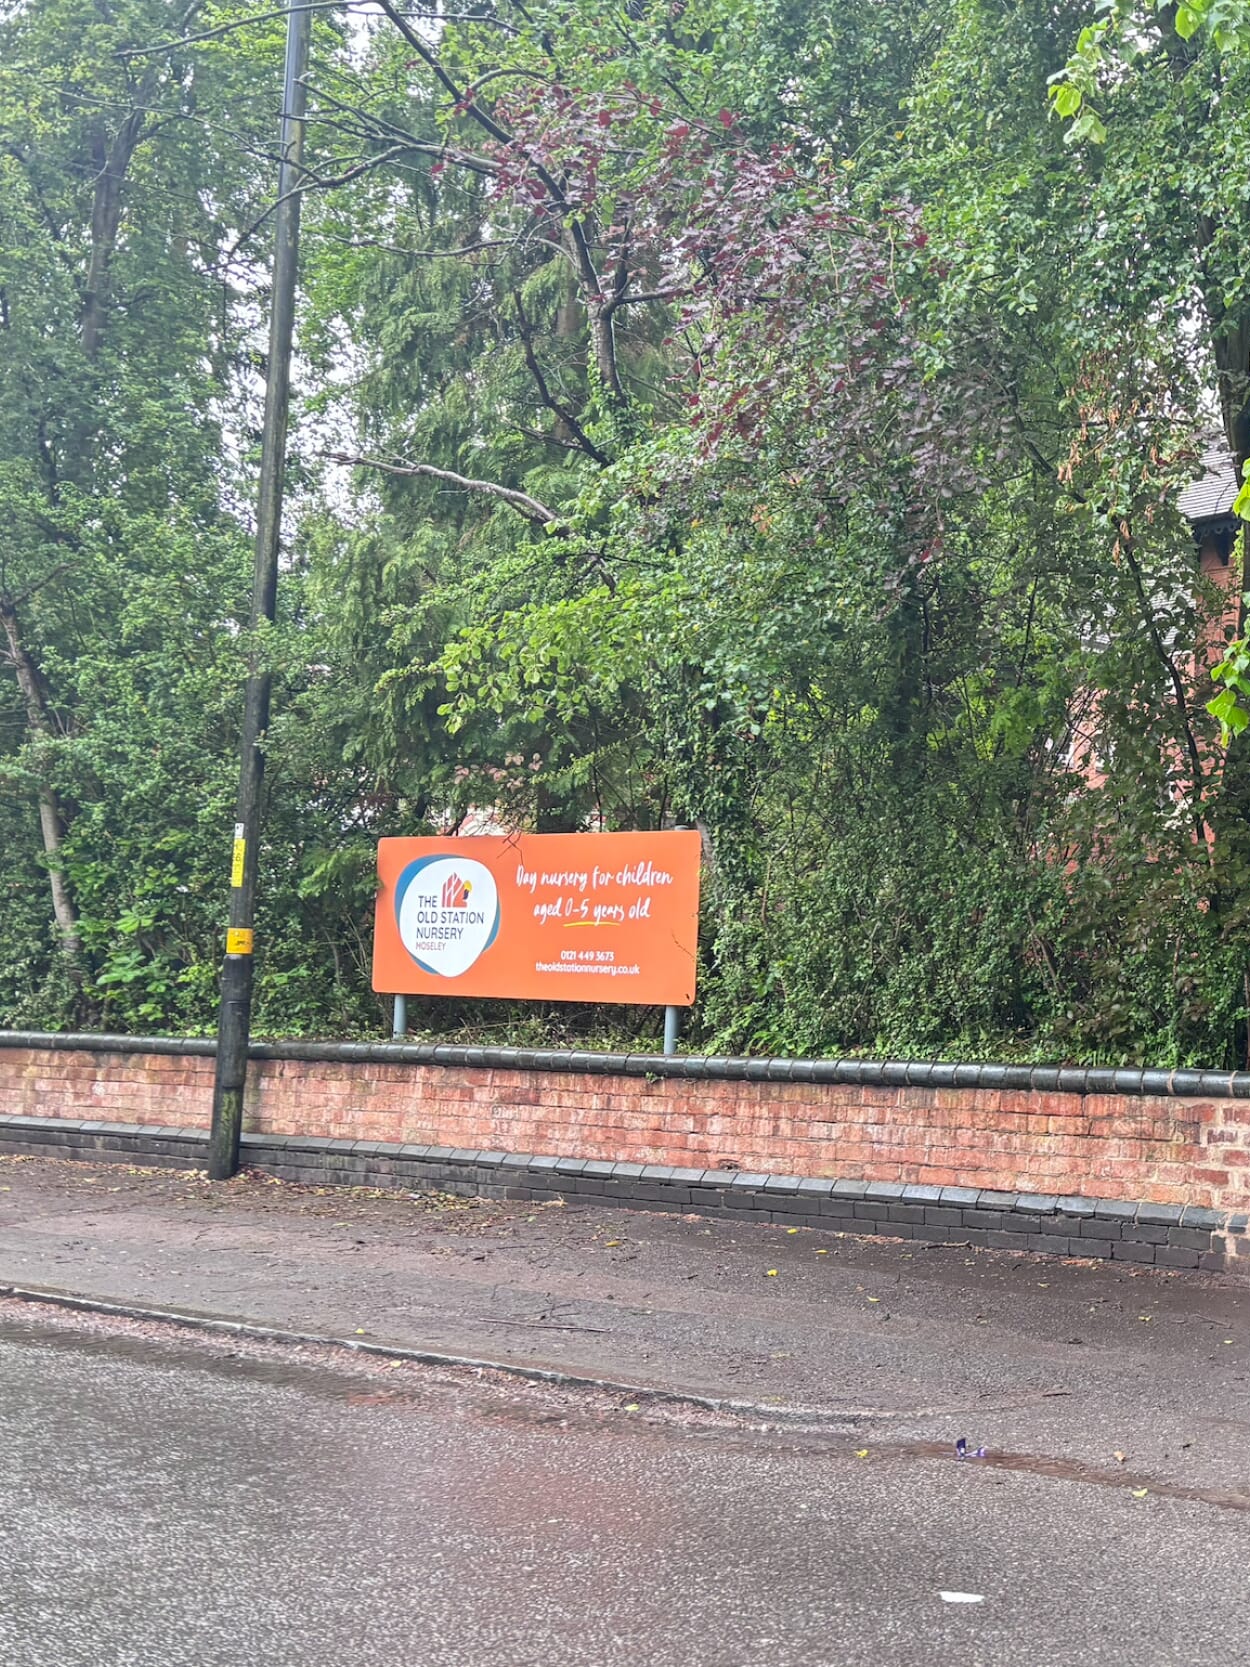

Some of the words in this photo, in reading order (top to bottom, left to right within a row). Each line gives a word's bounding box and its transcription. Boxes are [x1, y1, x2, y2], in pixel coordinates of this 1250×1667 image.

[516, 864, 537, 893] Day
[540, 871, 588, 892] nursery
[592, 865, 615, 889] for
[616, 861, 673, 886] children
[418, 895, 438, 908] THE
[417, 911, 438, 924] OLD
[440, 911, 484, 924] STATION
[533, 897, 562, 924] aged
[564, 898, 590, 918] 0-5
[593, 903, 625, 926] years
[628, 897, 651, 919] old
[416, 926, 464, 940] NURSERY
[560, 950, 577, 960] 0121
[578, 951, 594, 961] 449
[535, 961, 640, 976] theoldstationnursery.co.uk
